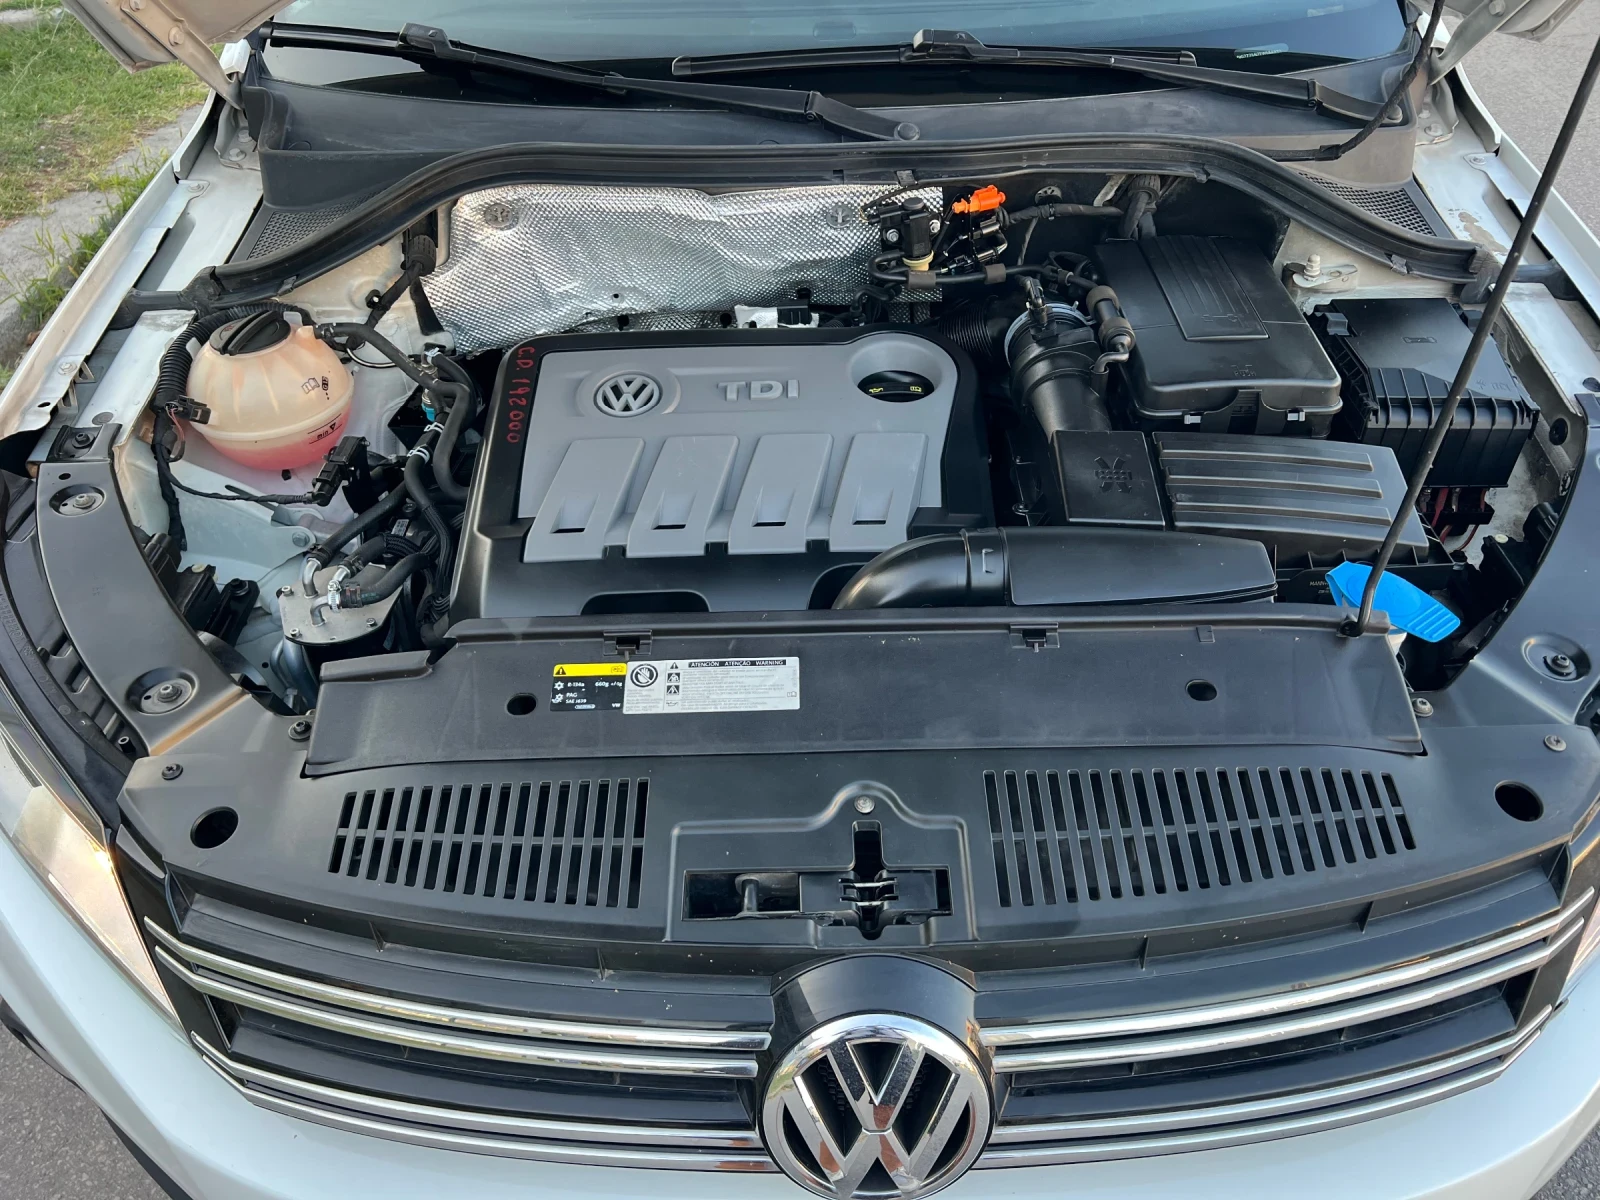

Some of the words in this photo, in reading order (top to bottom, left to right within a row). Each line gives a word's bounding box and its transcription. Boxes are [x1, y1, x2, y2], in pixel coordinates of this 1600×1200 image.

[598, 375, 659, 416] VW
[717, 379, 800, 401] TDI
[316, 429, 329, 440] min
[780, 1038, 976, 1198] VW
